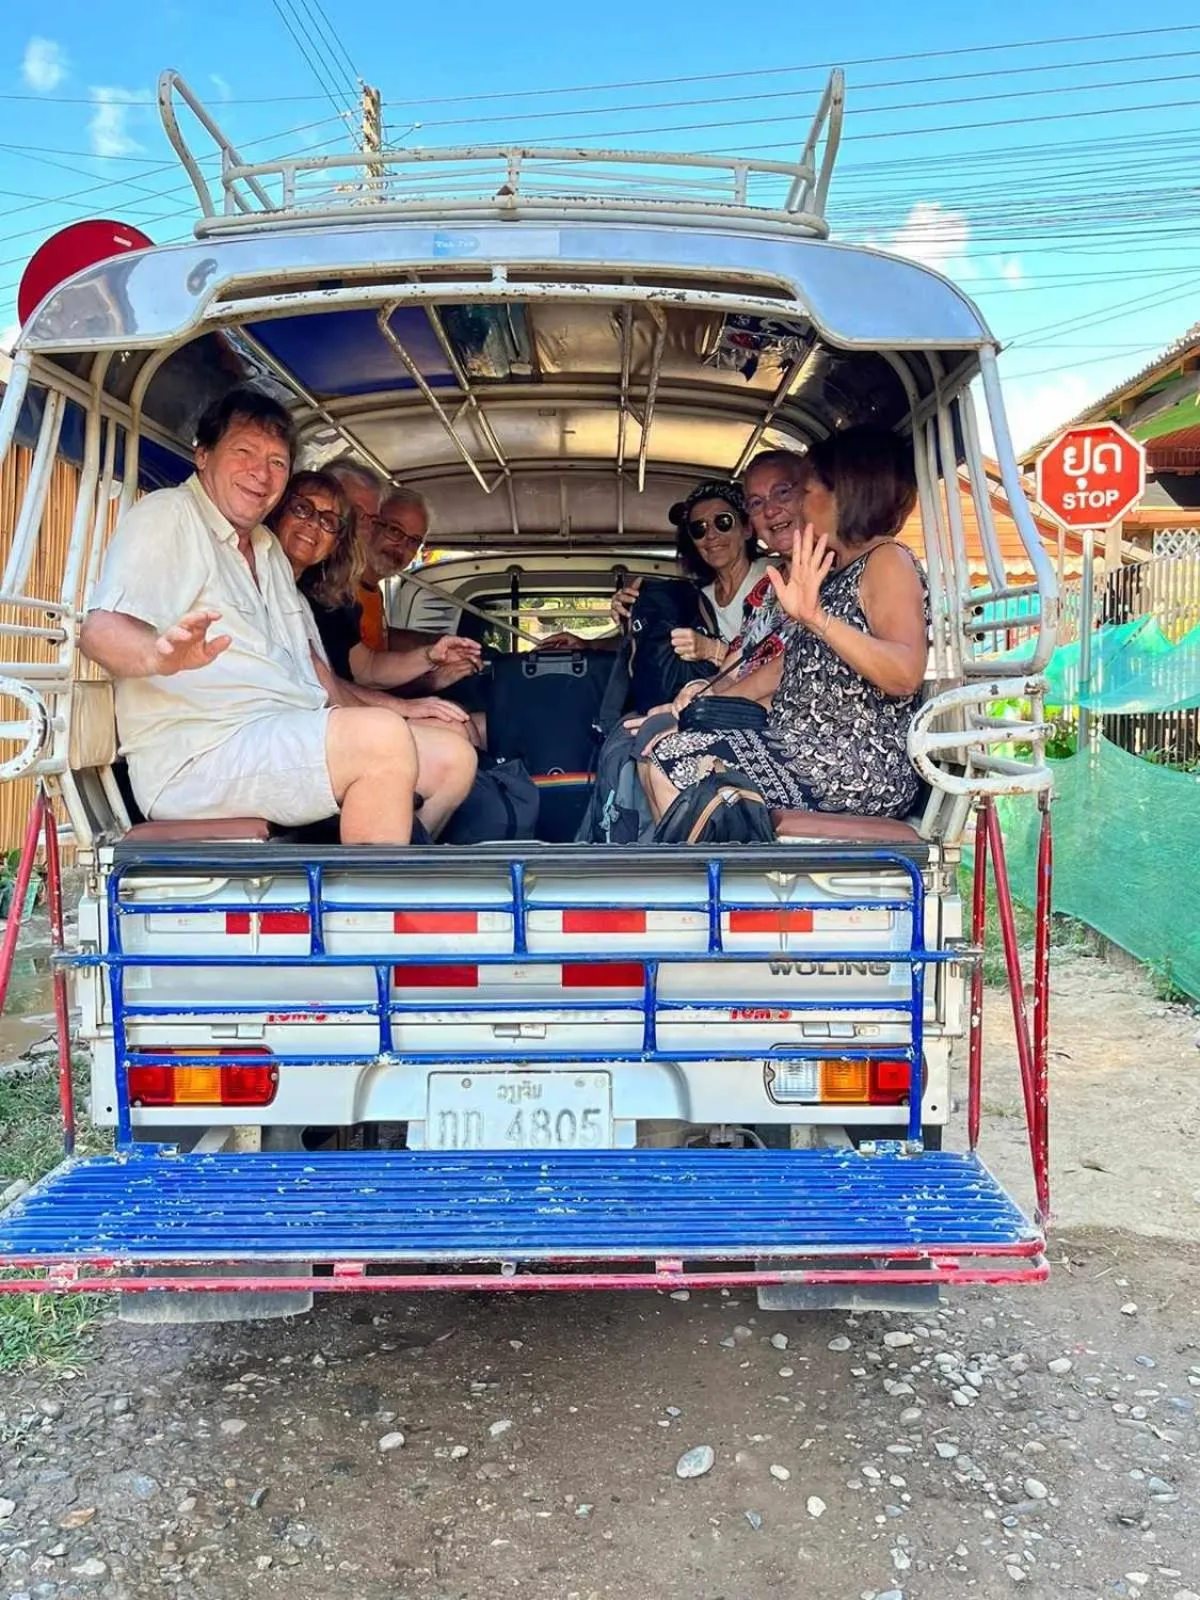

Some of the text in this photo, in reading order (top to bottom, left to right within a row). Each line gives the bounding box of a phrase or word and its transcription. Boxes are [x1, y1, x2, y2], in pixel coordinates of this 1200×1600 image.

[1063, 436, 1122, 490] ຢຸດ
[1062, 490, 1119, 510] STOP
[505, 1108, 603, 1149] 4805
